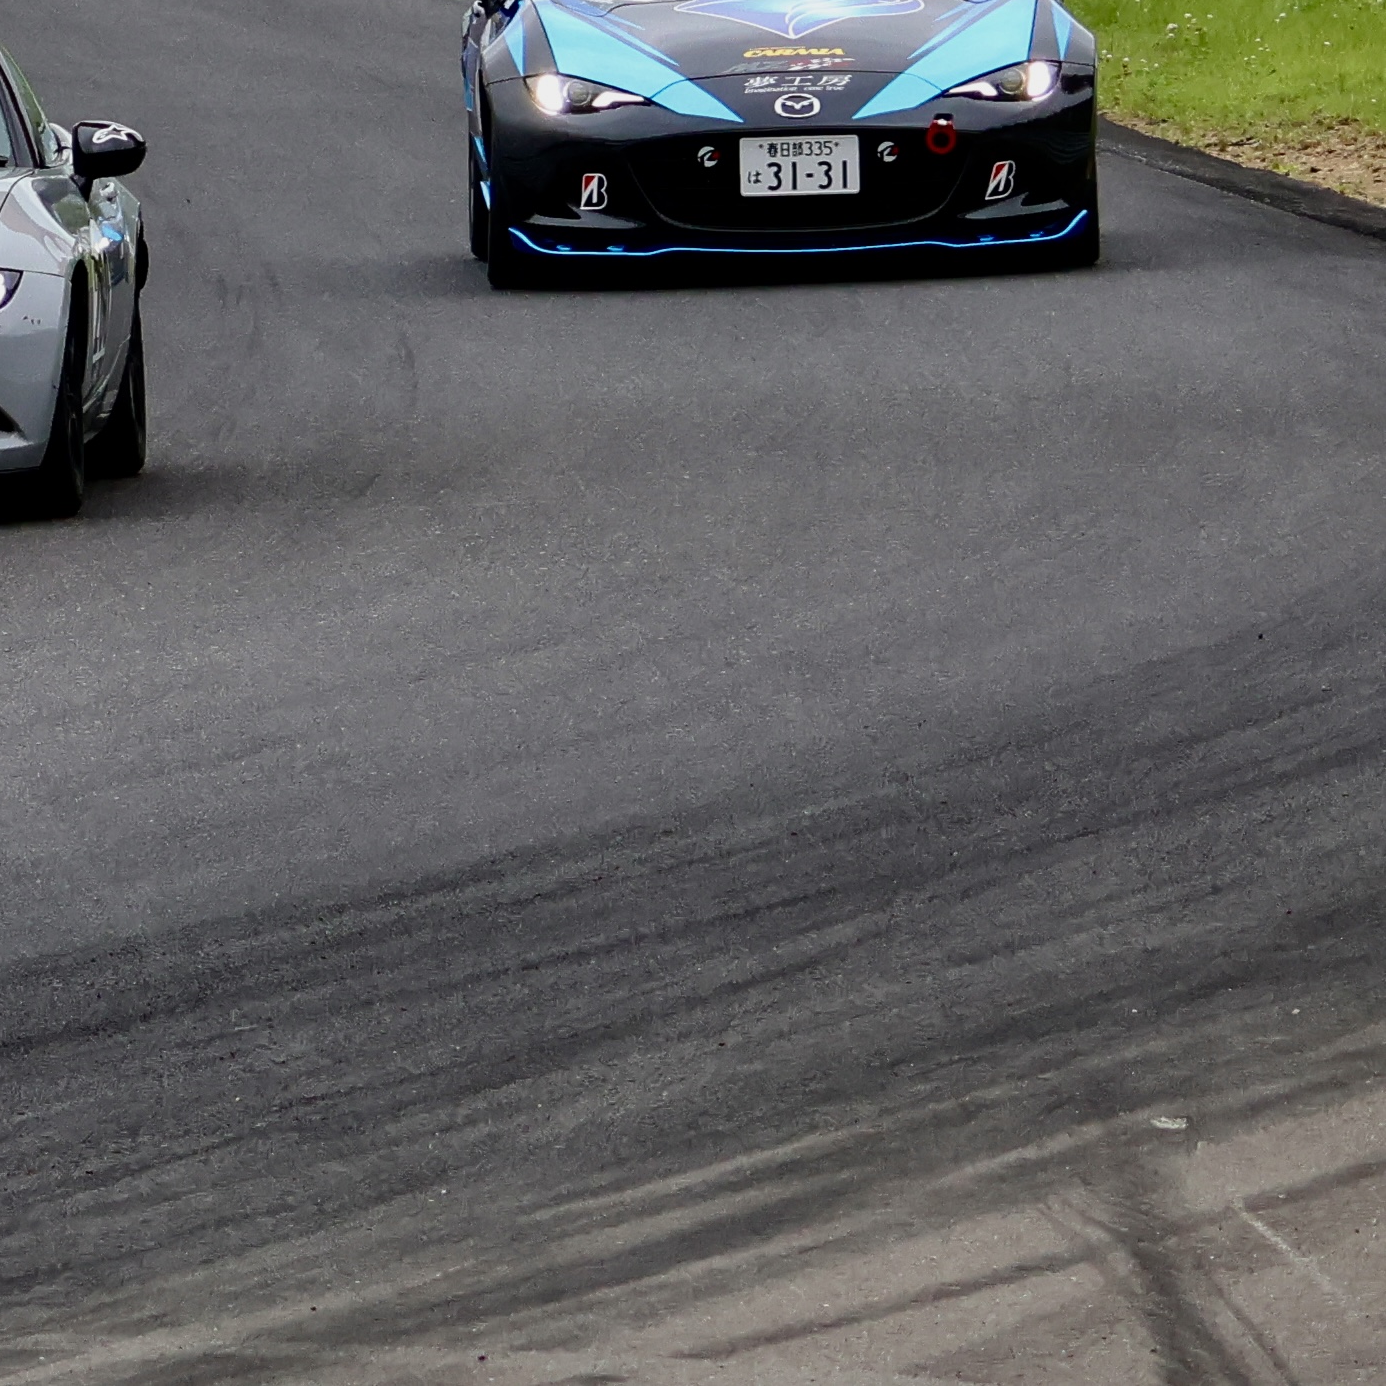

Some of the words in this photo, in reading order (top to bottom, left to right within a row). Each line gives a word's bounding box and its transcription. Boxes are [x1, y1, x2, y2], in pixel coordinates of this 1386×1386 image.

[766, 141, 834, 157] 春日部335
[747, 170, 762, 185] は
[766, 160, 848, 191] 31-31
